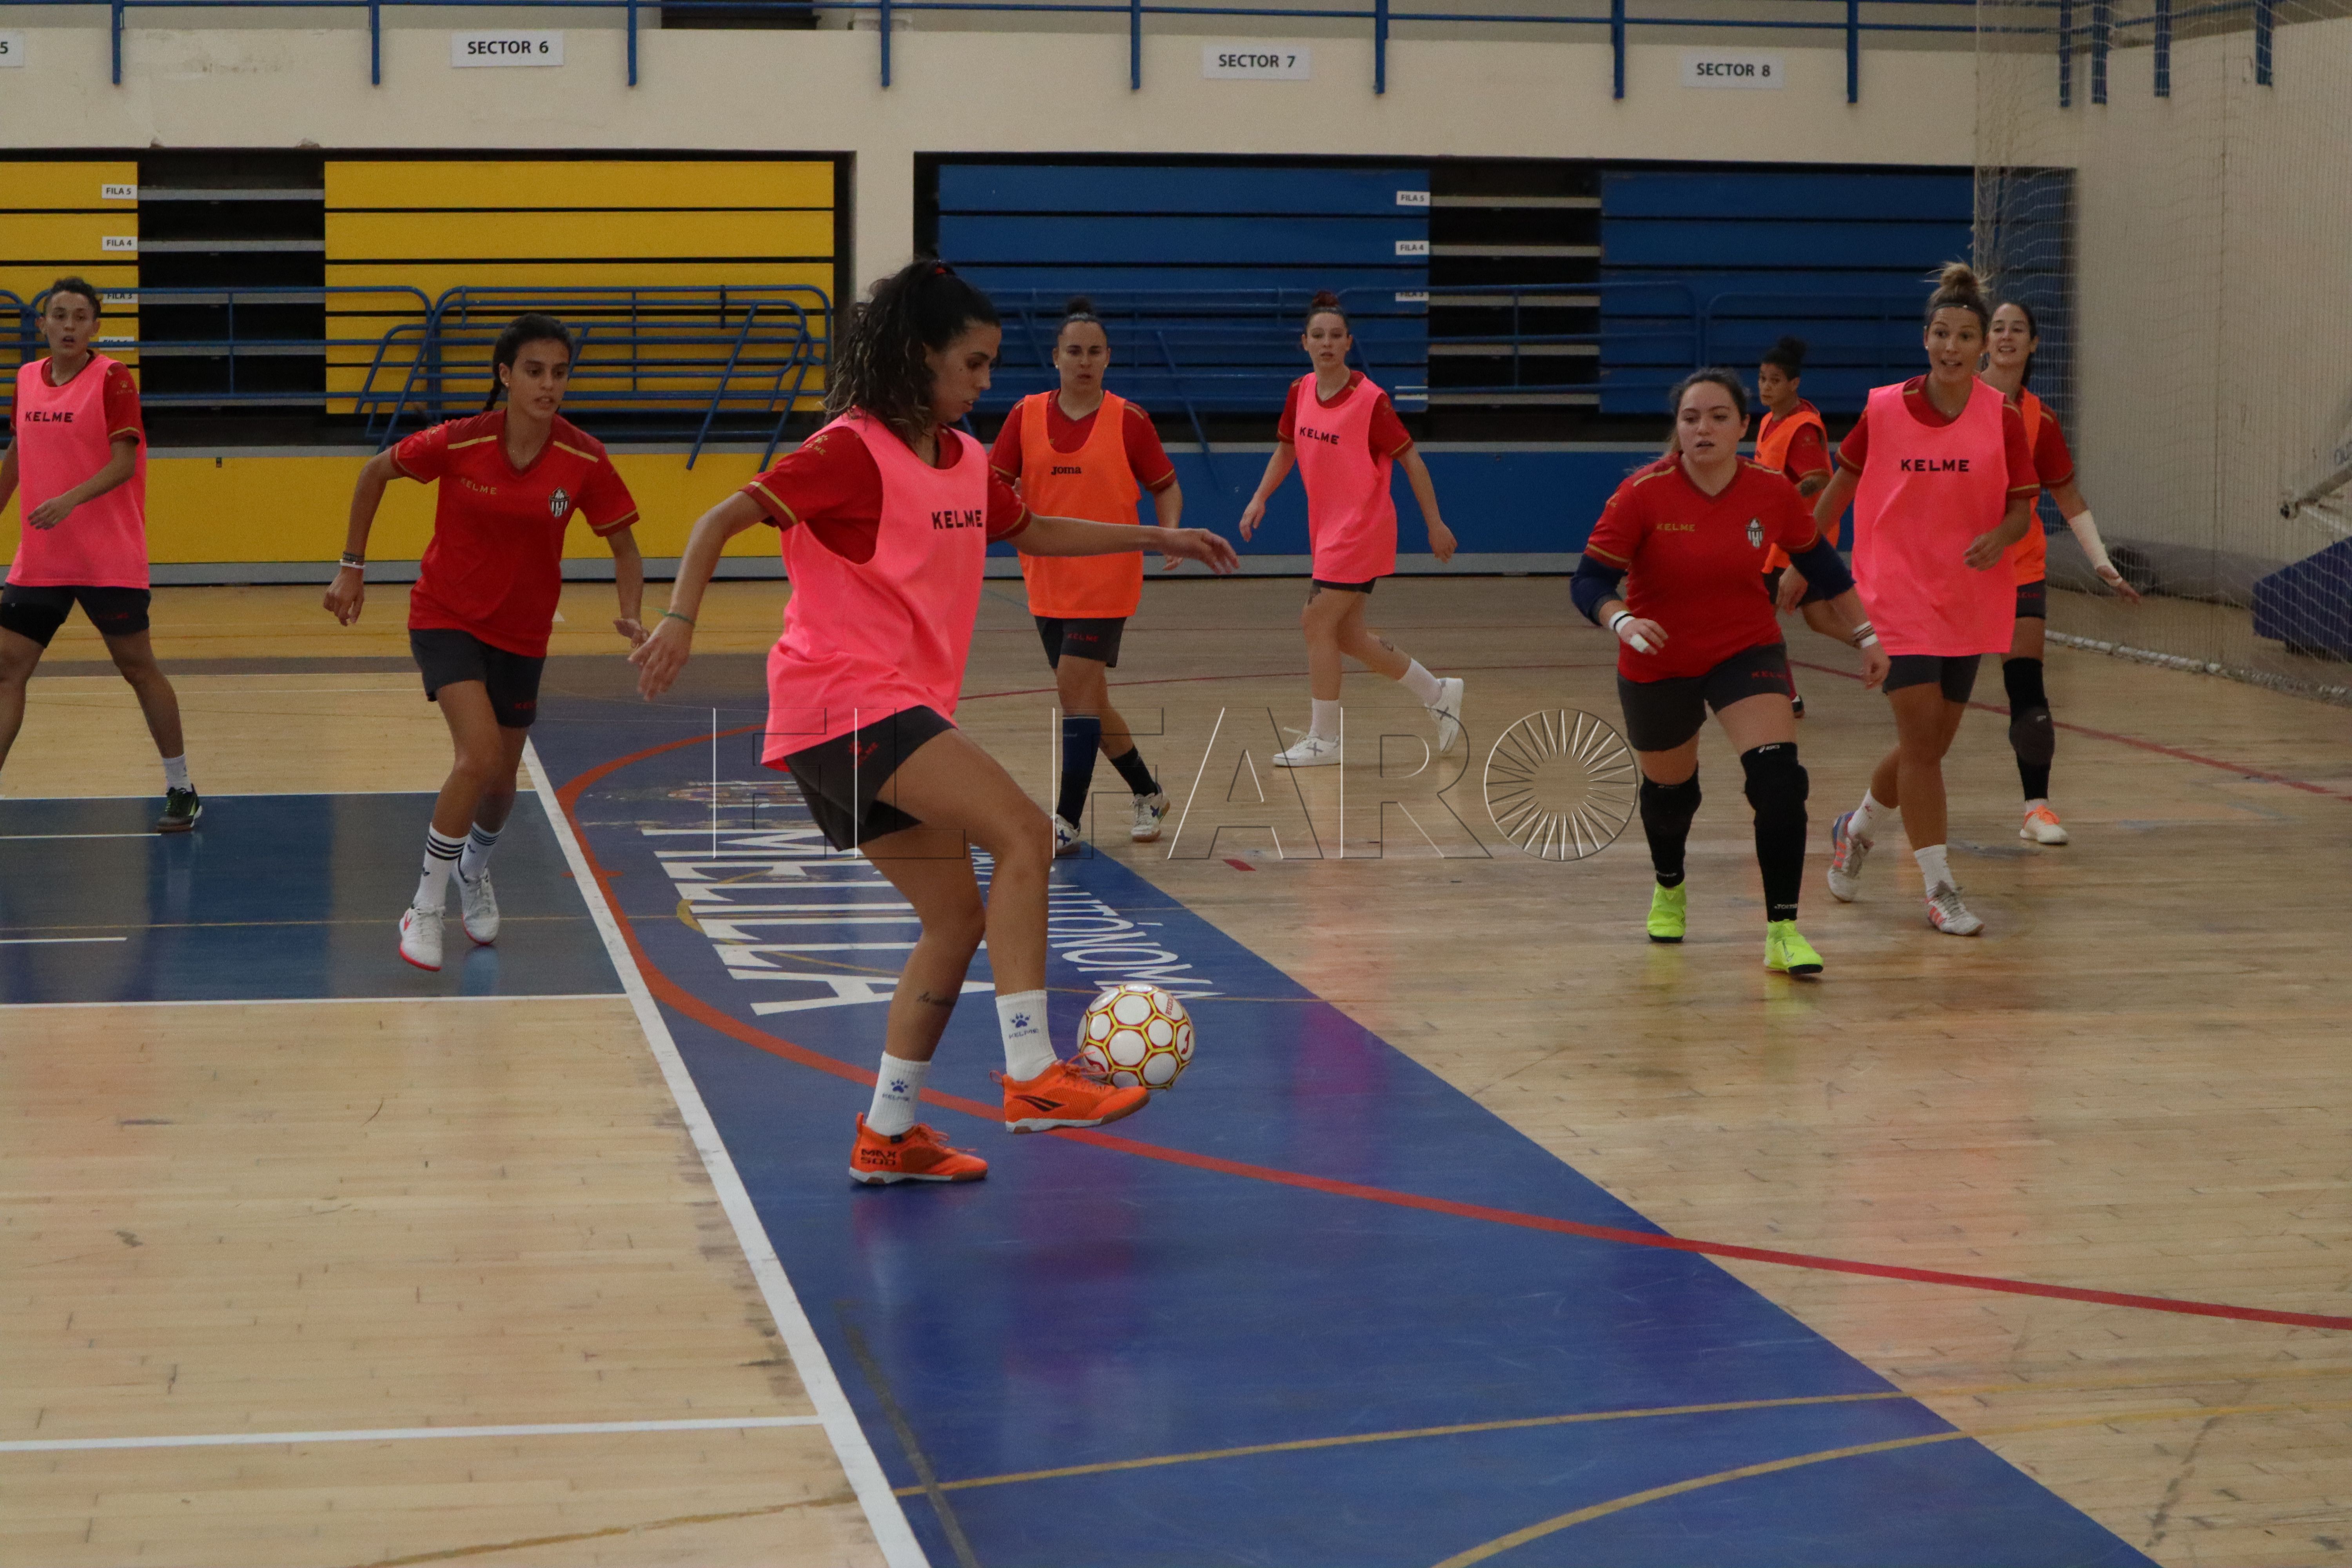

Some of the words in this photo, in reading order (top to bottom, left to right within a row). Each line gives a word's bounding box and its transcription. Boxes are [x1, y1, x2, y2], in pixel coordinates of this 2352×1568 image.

[0, 41, 8, 54] 5
[468, 41, 531, 54] SECTOR
[539, 41, 549, 54] 6
[1219, 54, 1279, 67] SECTOR
[1287, 55, 1296, 68] 7
[1697, 63, 1754, 76] SECTOR
[1762, 65, 1771, 77] 8
[25, 411, 74, 423] KELME
[1299, 426, 1340, 445] KELME
[1051, 466, 1082, 475] Joma
[1901, 459, 1969, 472] KELME
[460, 477, 497, 495] KELME
[931, 510, 983, 530] KELME
[1657, 523, 1696, 532] KELME
[642, 828, 996, 1016] MELILLA
